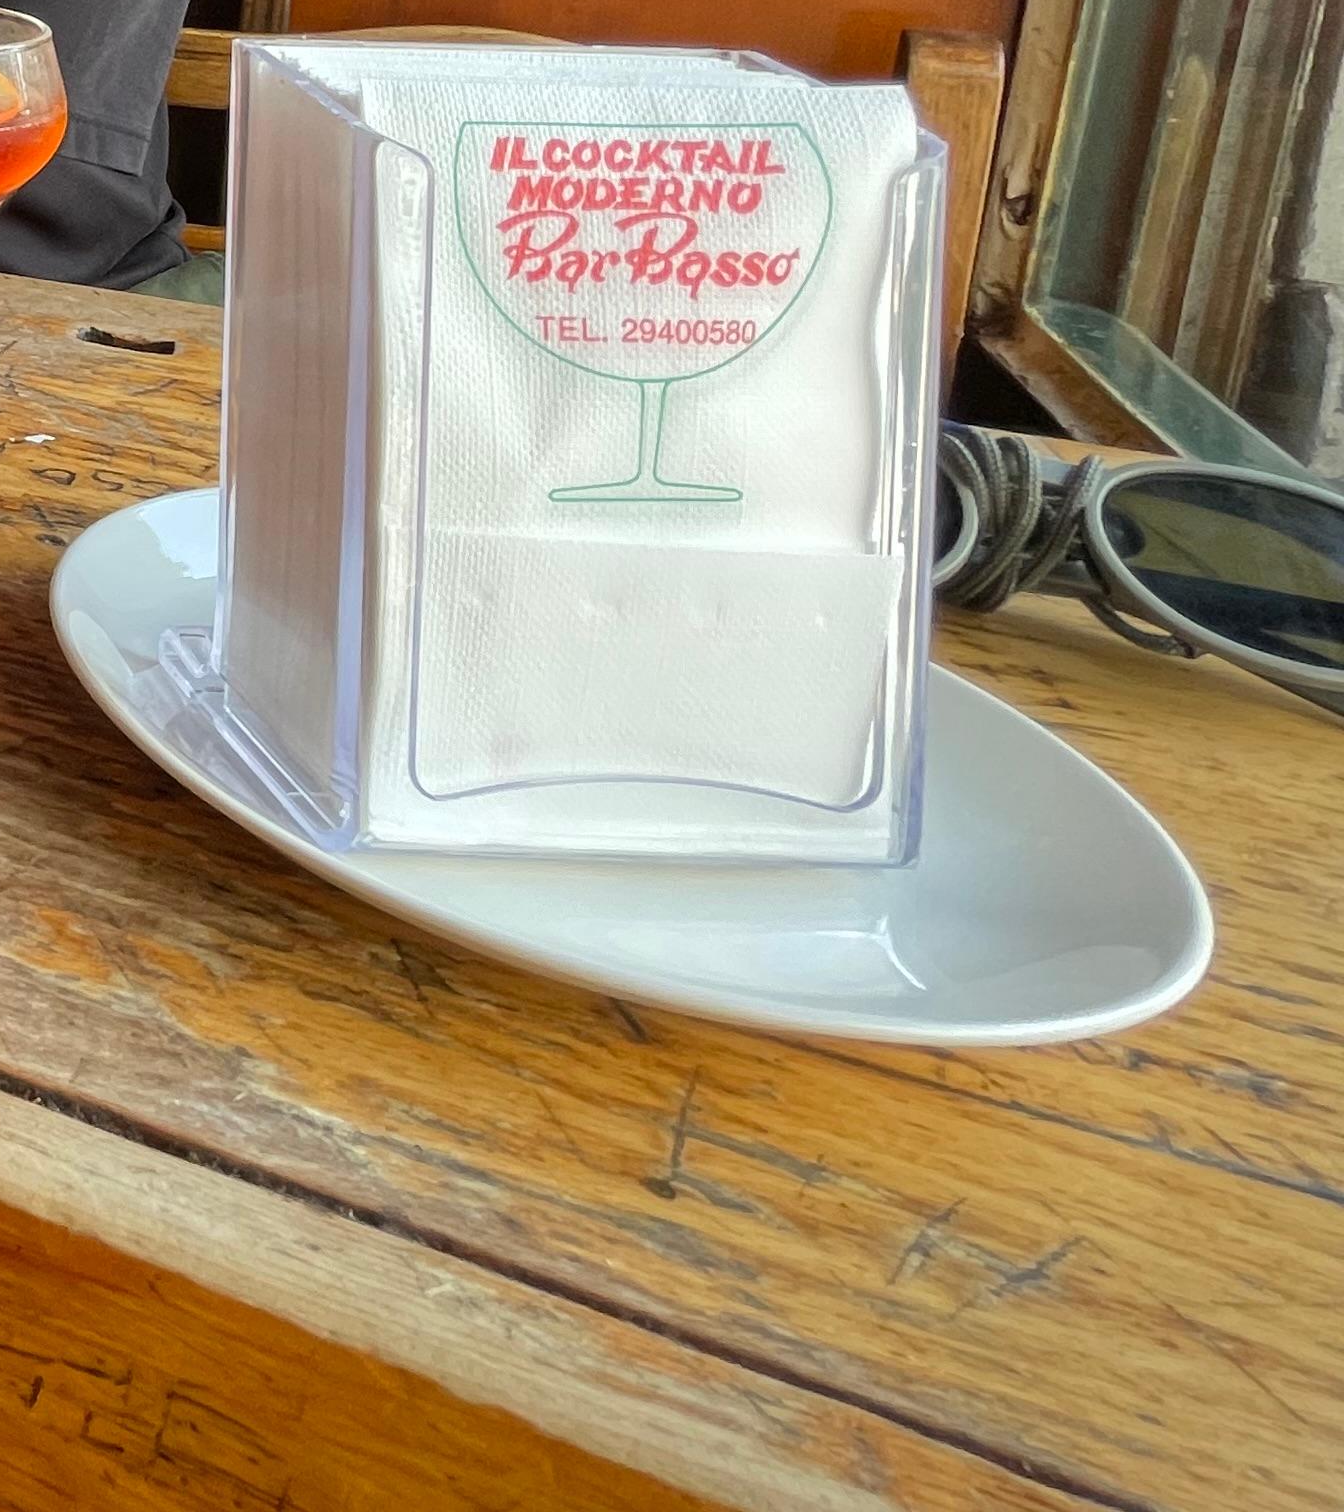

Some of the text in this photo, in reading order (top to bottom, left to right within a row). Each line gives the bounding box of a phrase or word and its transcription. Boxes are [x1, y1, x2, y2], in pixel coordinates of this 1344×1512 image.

[506, 176, 764, 216] MODERNO
[535, 315, 757, 345] TEL. 29400580
